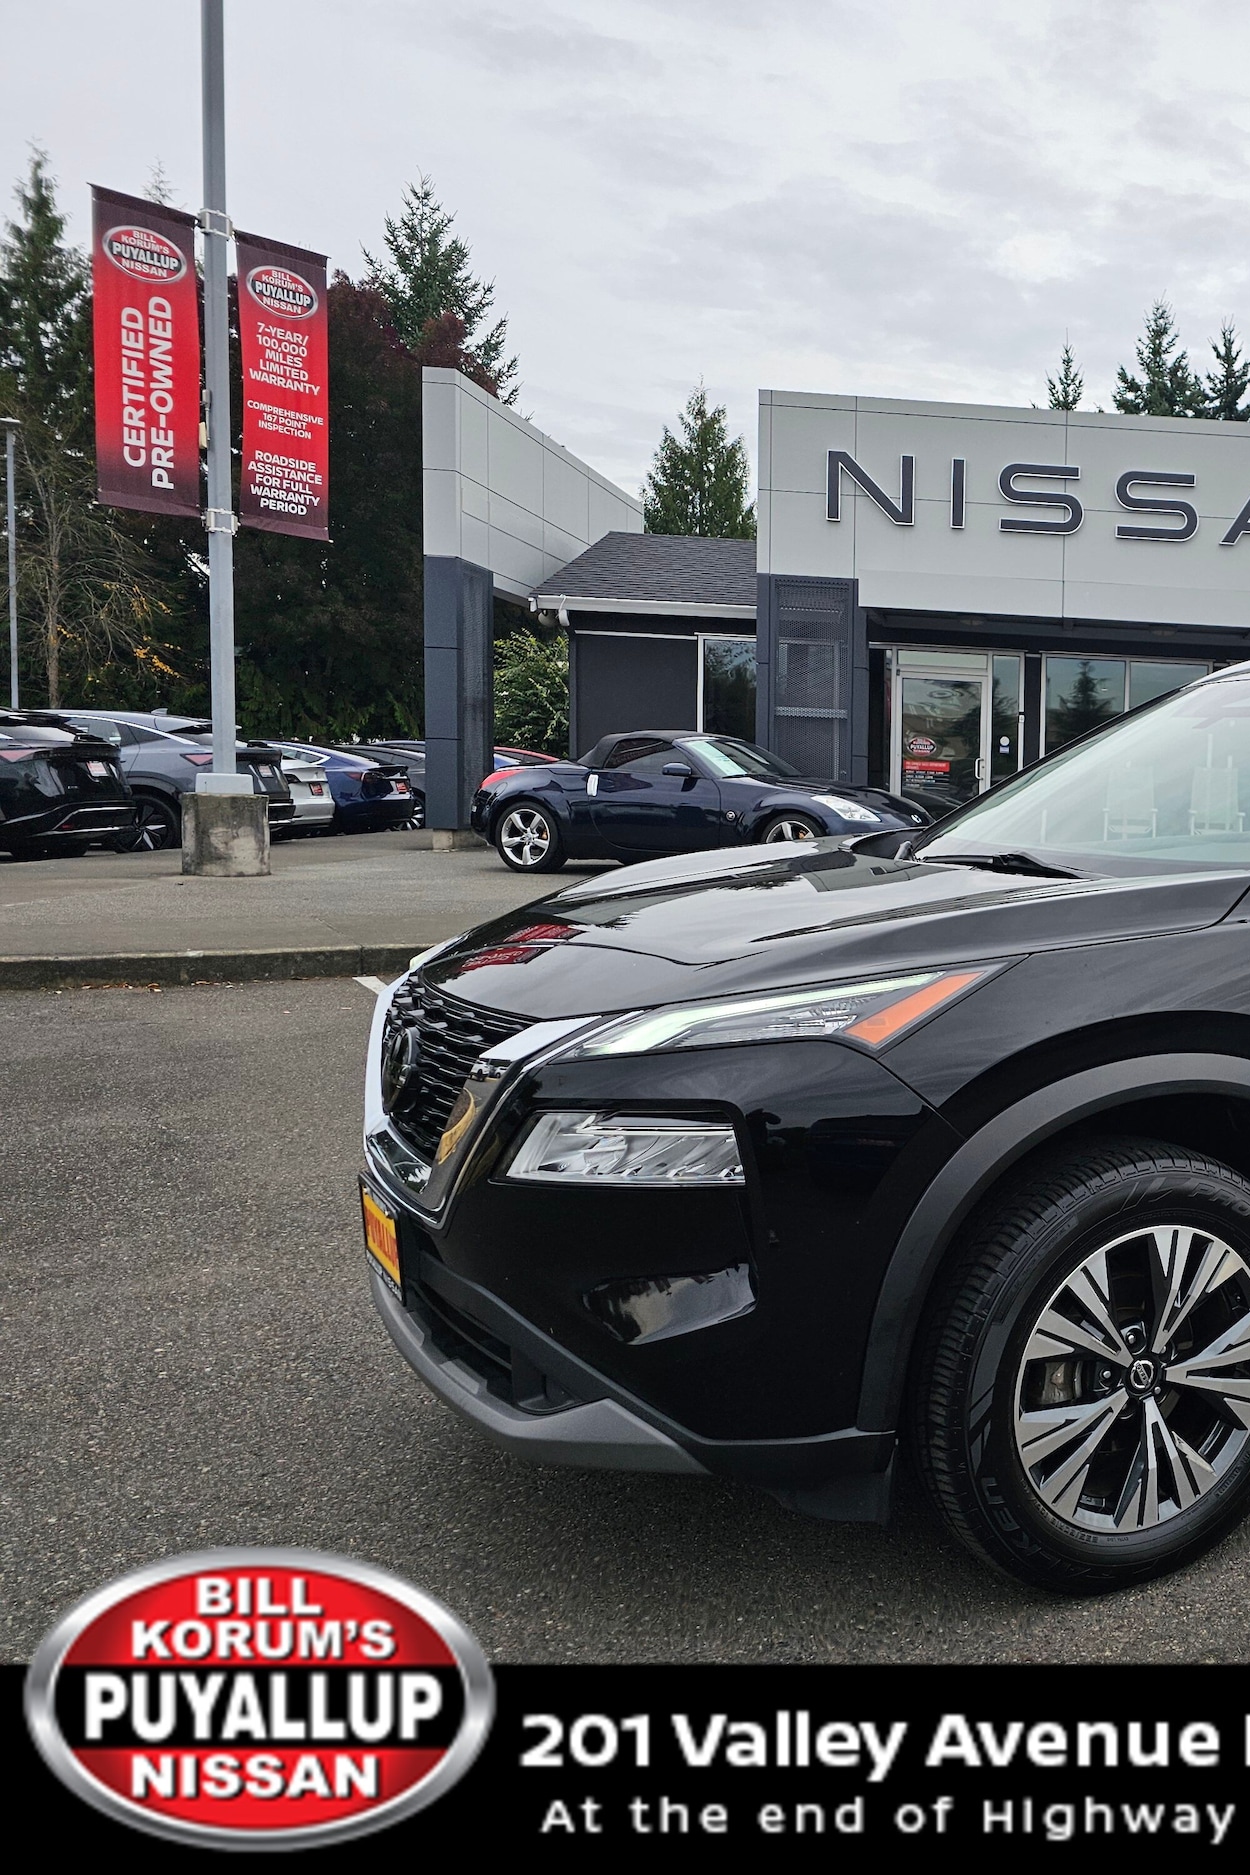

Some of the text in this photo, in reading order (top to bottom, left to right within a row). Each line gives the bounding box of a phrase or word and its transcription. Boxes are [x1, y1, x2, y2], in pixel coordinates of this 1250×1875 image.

[121, 234, 170, 254] KORUM'S
[133, 230, 157, 243] BILL
[112, 241, 179, 270] PUYALLUP
[121, 259, 167, 278] NISSAN
[272, 270, 292, 283] BILL
[255, 281, 311, 307] PUYALLUP
[261, 274, 304, 292] KORUM'S
[262, 296, 302, 314] NISSAN
[257, 321, 309, 346] 7-YEAR/
[256, 334, 307, 357] 100,000
[259, 358, 309, 381] LIMITED
[265, 348, 303, 368] MILES
[121, 306, 147, 468] CERTIFIED
[149, 296, 175, 490] PRE-OWNED
[249, 367, 320, 396] WARRANTY
[247, 400, 324, 426] COMPREHENSIVE
[263, 412, 308, 430] 167 POINT
[258, 419, 312, 440] INSPECTION
[247, 460, 323, 485] ASSISTANCE
[255, 449, 317, 473] ROADSIDE
[250, 484, 320, 507] WARRANTY
[255, 473, 313, 495] FOR FULL
[260, 497, 308, 516] PERIOD
